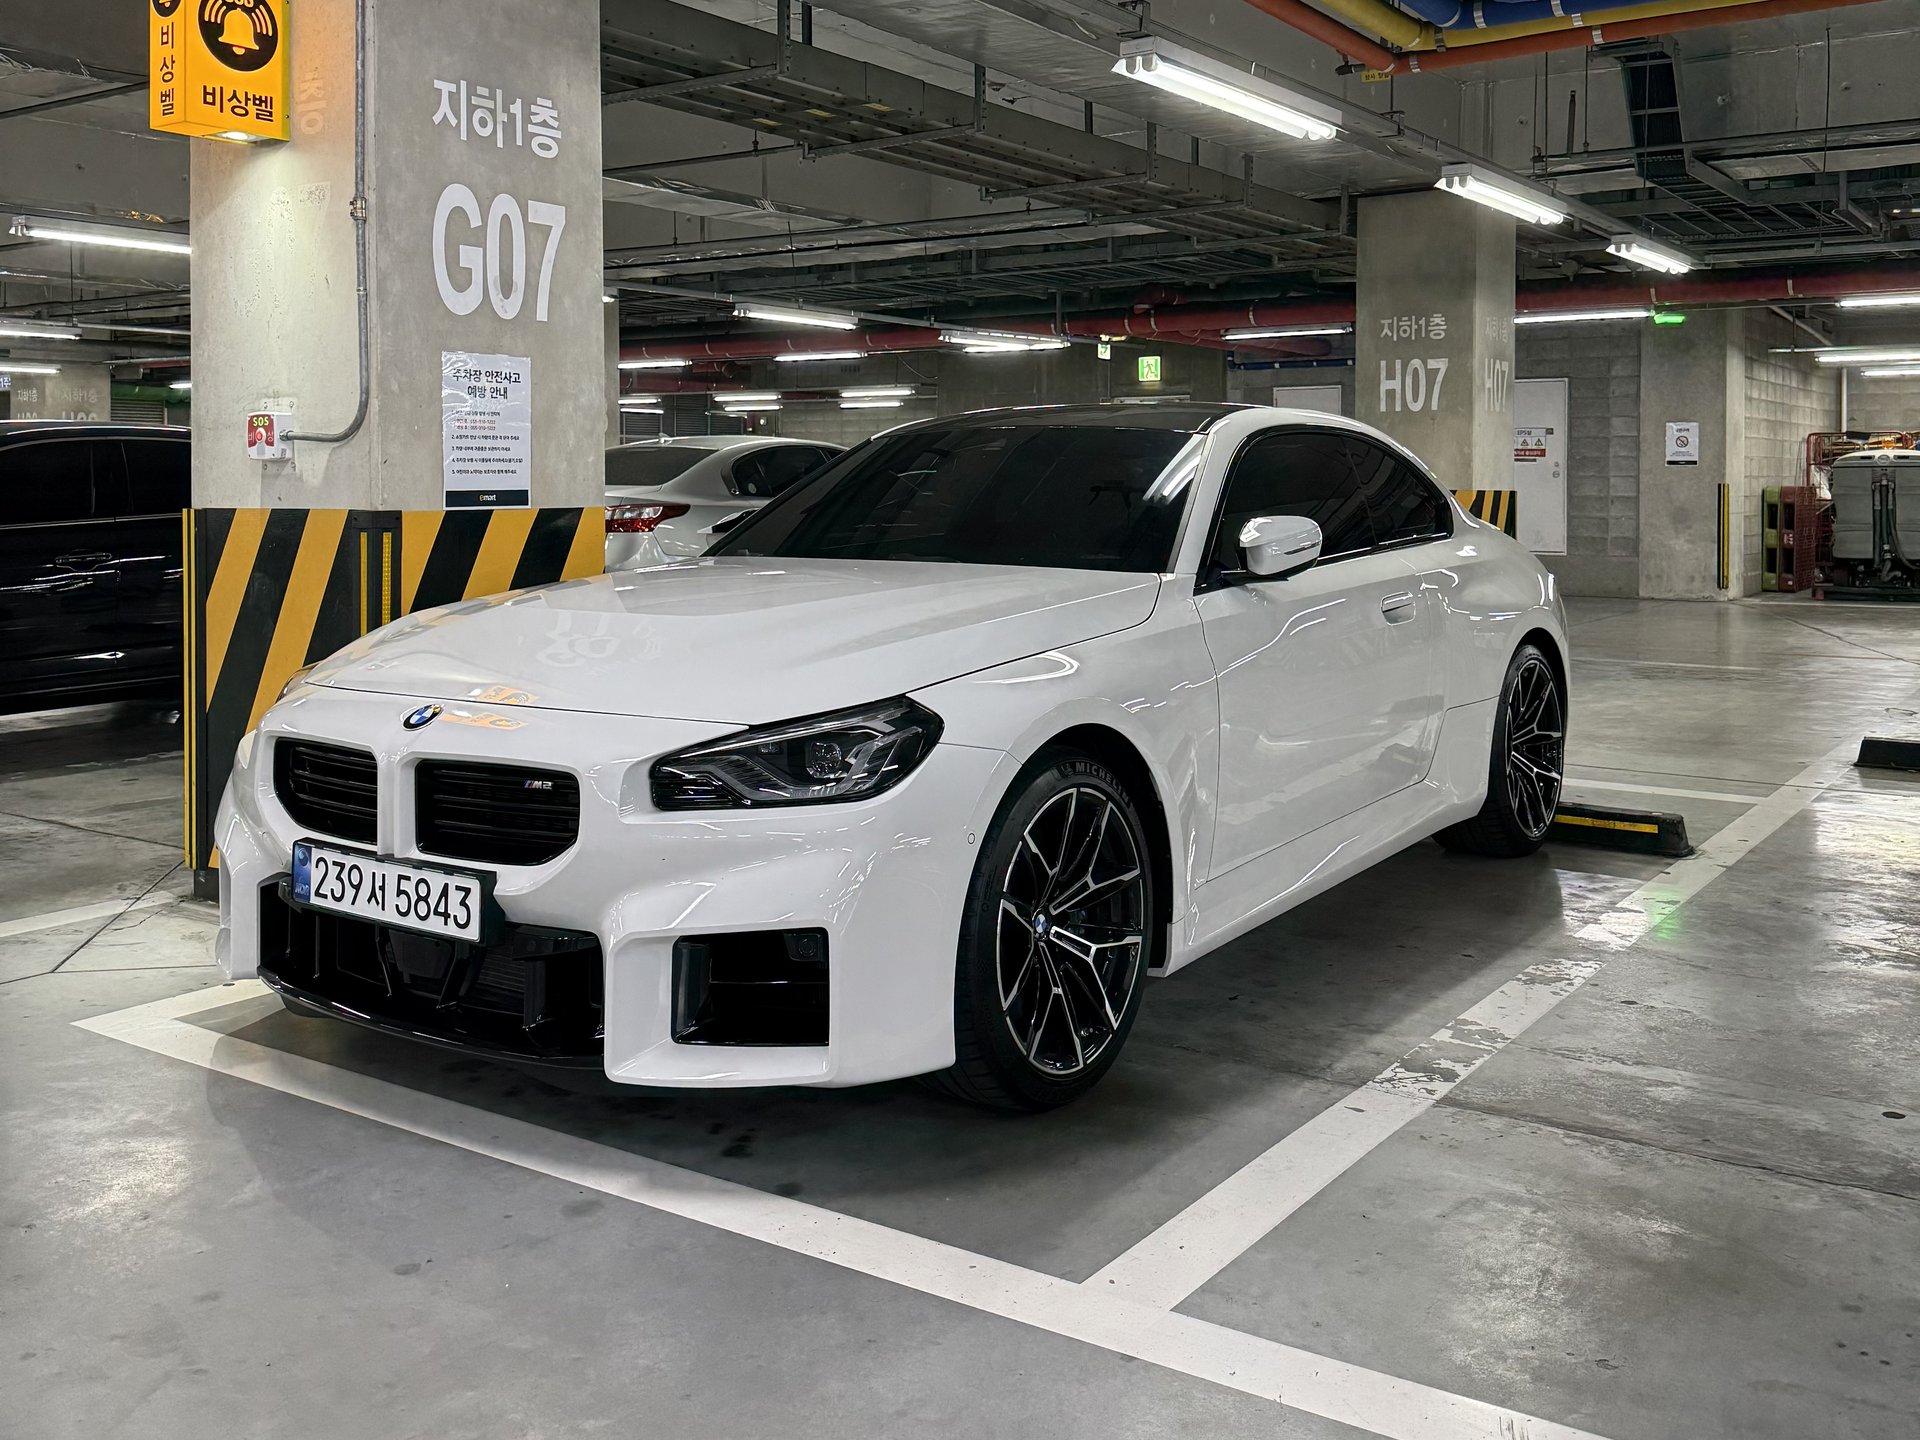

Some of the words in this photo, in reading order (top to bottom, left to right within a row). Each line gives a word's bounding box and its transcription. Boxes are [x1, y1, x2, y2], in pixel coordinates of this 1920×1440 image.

[160, 22, 175, 117] 비상벨
[202, 85, 274, 123] 비상벨
[432, 79, 562, 158] 지하1층
[432, 183, 566, 322] G07
[1380, 313, 1448, 342] 지하1층
[453, 368, 482, 383] 주차장
[485, 370, 521, 384] 안전사고
[467, 385, 486, 399] 예방
[490, 386, 508, 400] 안내
[1380, 358, 1449, 413] H07
[1485, 357, 1509, 413] H07
[253, 417, 269, 426] SOS
[525, 780, 554, 790] M2
[1075, 762, 1129, 803] MICHELIN
[315, 856, 386, 912] 239서
[395, 874, 472, 930] 5843
